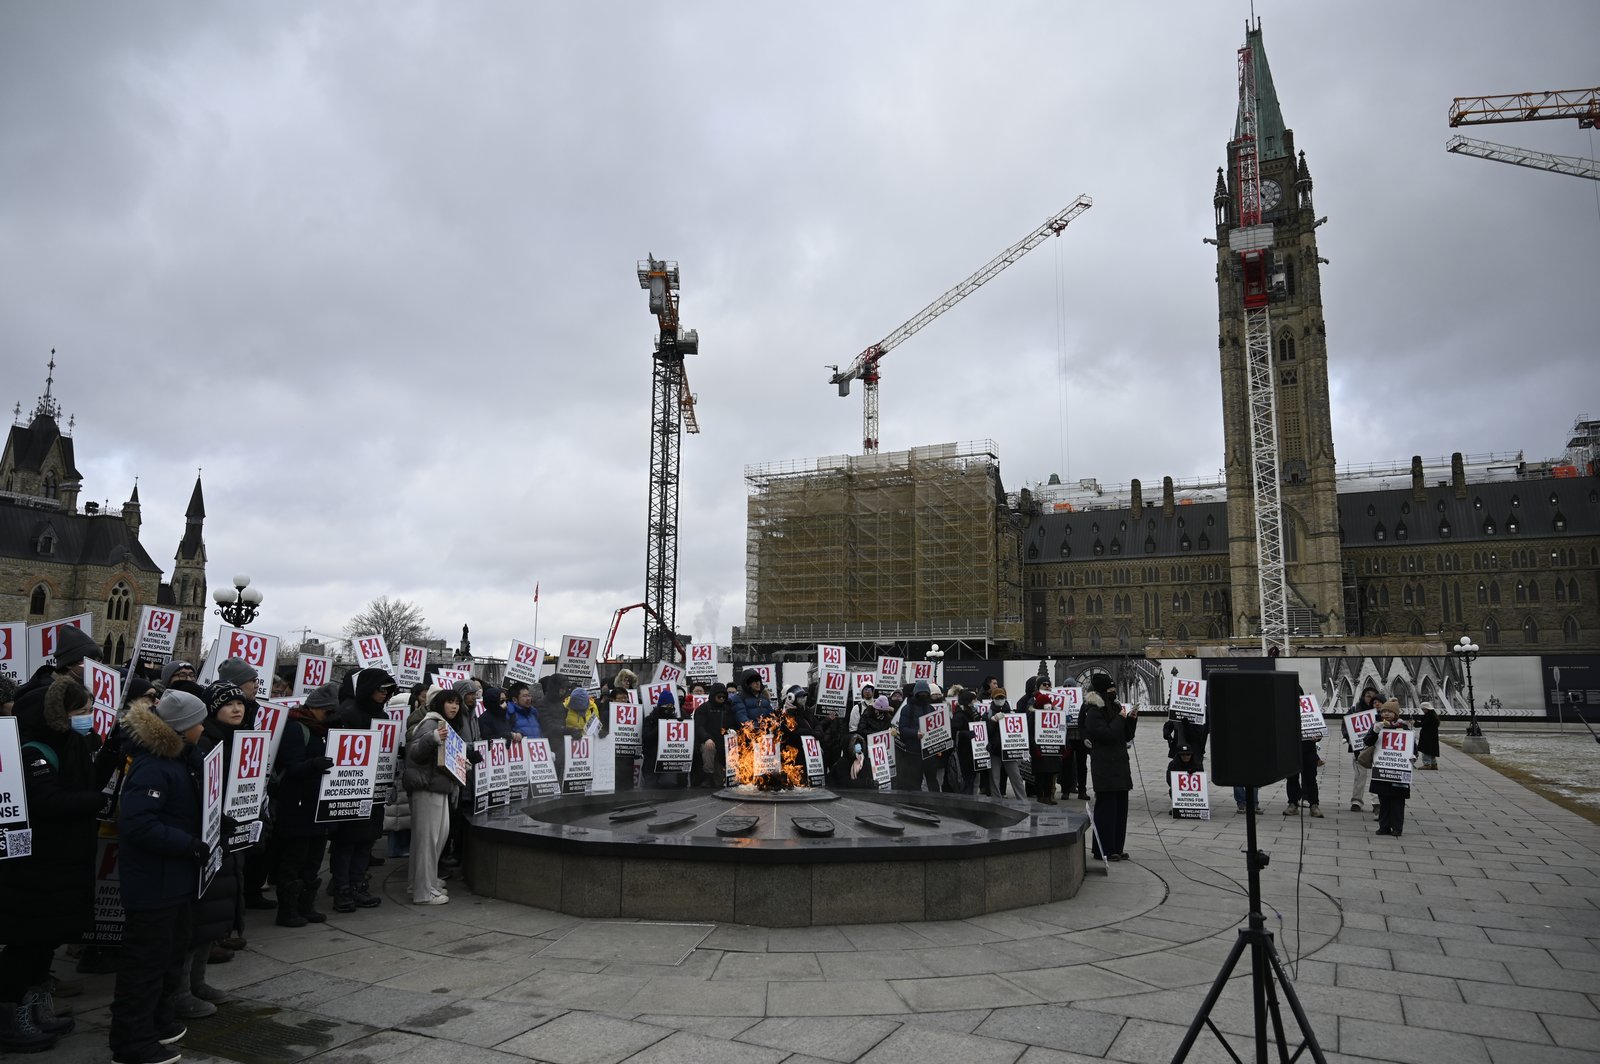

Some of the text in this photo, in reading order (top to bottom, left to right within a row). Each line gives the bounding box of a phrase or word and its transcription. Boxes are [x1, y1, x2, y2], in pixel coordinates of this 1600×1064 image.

[152, 611, 170, 631] 62
[232, 634, 263, 665] 39
[362, 639, 380, 658] 34
[518, 646, 535, 666] 42
[570, 640, 589, 658] 42
[694, 646, 710, 660] 23
[825, 648, 839, 662] 29
[406, 649, 419, 668] 34
[884, 660, 896, 674] 40
[306, 660, 324, 685] 39
[917, 665, 928, 678] 31
[93, 668, 112, 707] 23
[829, 673, 843, 689] 70
[1180, 682, 1197, 697] 72
[618, 706, 635, 724] 34
[928, 712, 942, 730] 30
[1043, 712, 1058, 728] 40
[1355, 715, 1371, 731] 40
[670, 723, 686, 741] 51
[974, 725, 984, 740] 90
[1007, 717, 1021, 732] 65
[380, 724, 392, 753] 11
[1386, 733, 1404, 750] 14
[241, 738, 261, 778] 34
[341, 736, 367, 766] 19
[493, 743, 504, 766] 36
[530, 742, 546, 762] 35
[573, 740, 588, 758] 20
[330, 779, 356, 787] WAITING
[338, 788, 371, 796] RESPONSE
[1181, 775, 1199, 791] 36
